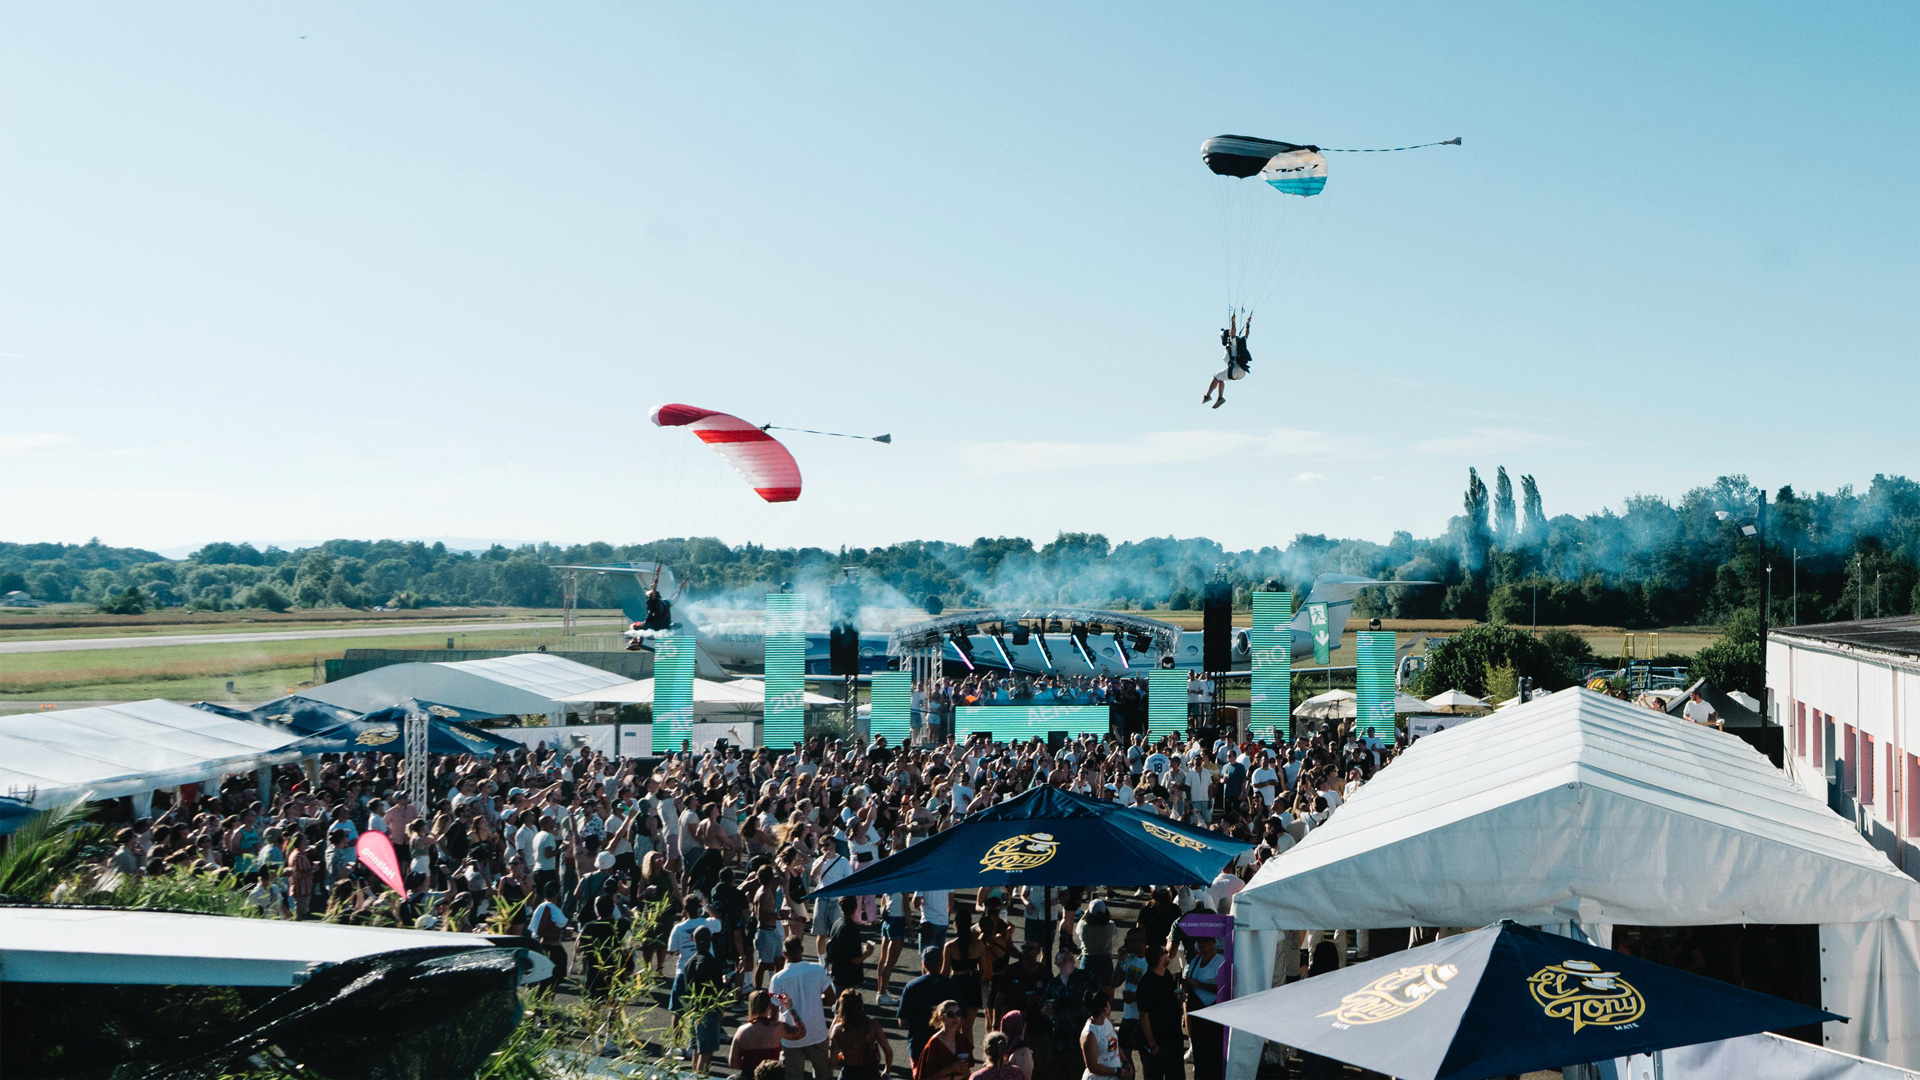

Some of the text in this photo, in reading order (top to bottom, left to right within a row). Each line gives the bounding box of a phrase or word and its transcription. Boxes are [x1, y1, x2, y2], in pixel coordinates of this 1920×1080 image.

[1153, 762, 1163, 774] 18
[979, 852, 1048, 874] Tony
[1544, 993, 1638, 1034] Tony
[1614, 1022, 1640, 1031] MATE
